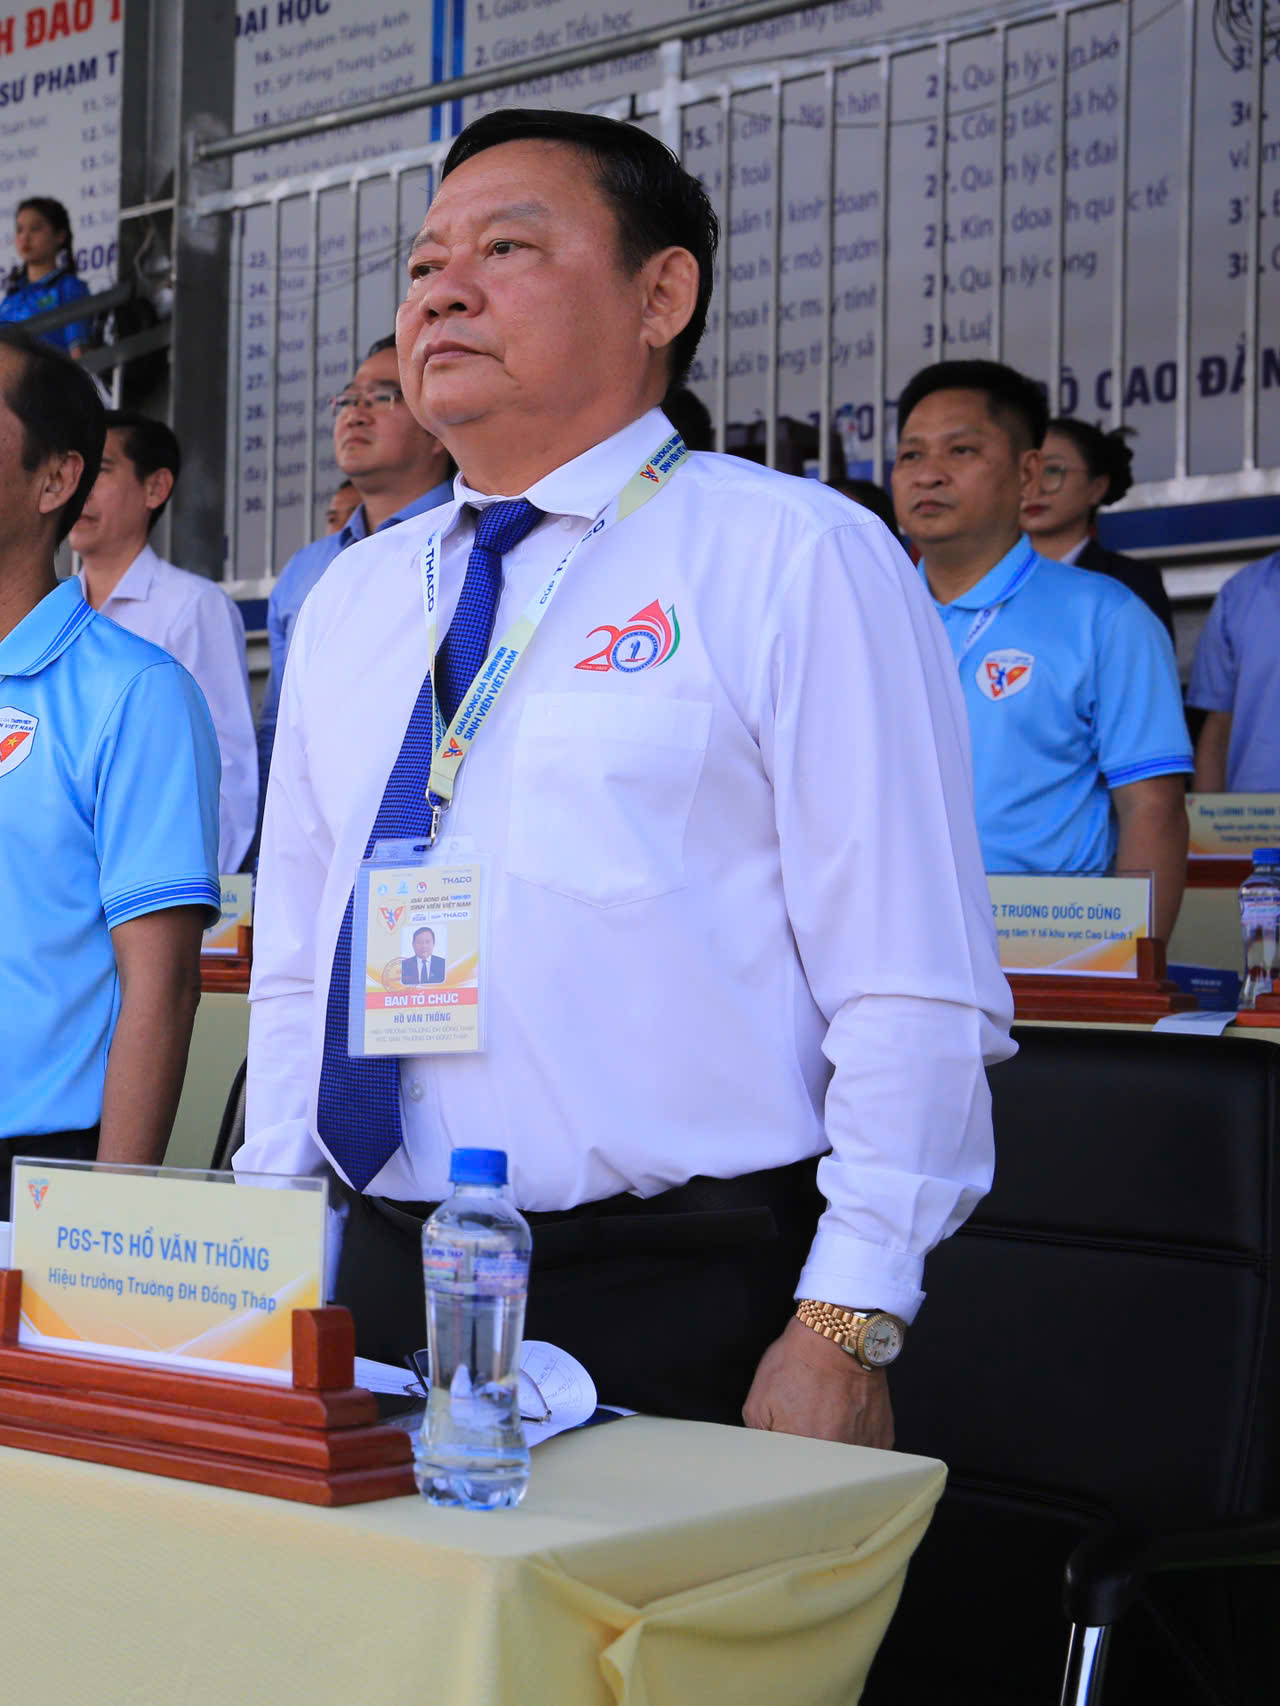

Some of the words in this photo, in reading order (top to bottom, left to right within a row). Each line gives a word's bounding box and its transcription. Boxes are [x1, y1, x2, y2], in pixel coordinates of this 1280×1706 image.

[426, 548, 434, 612] THACO
[464, 716, 482, 741] SINH
[476, 693, 495, 718] VIÊN
[501, 650, 519, 675] NAM
[441, 876, 472, 885] THACO
[1051, 901, 1084, 920] QUỐC
[1085, 930, 1102, 940] Cao
[384, 995, 408, 1006] BAN
[57, 1226, 124, 1256] PGS-TS
[129, 1226, 154, 1259] HỒ
[159, 1234, 197, 1265] VĂN
[203, 1237, 270, 1273] THỐNG
[48, 1267, 77, 1291] Hiệu
[80, 1271, 124, 1297] trưởng
[127, 1276, 174, 1303] Trường
[178, 1282, 198, 1301] ĐH
[201, 1284, 238, 1311] Đồng
[241, 1290, 277, 1315] Tháp
